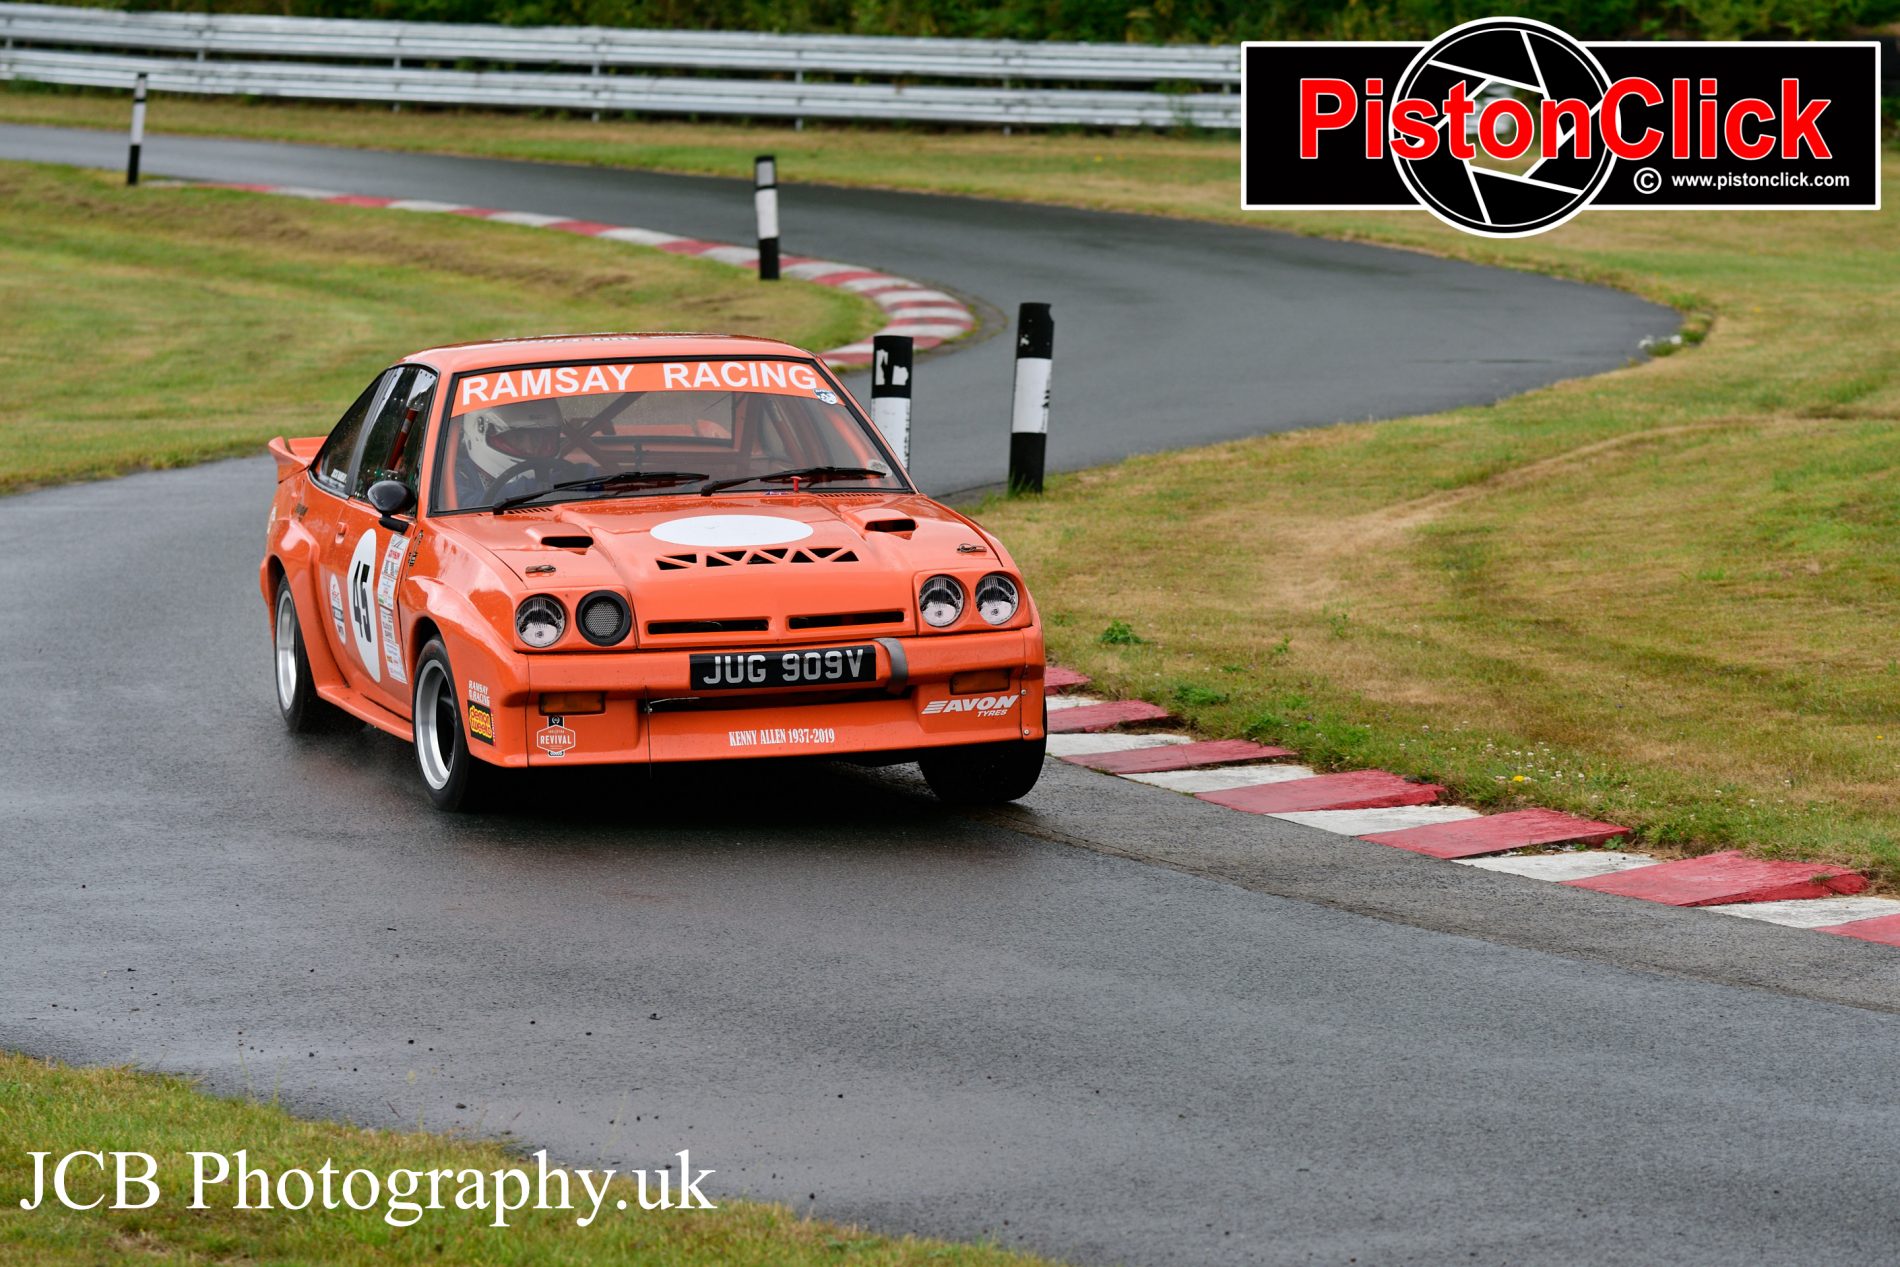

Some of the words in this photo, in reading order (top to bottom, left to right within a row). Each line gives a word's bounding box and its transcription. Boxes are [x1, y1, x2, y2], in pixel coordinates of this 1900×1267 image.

[462, 364, 634, 406] RAMSAY
[664, 360, 818, 390] RACING
[353, 560, 372, 644] 45
[703, 653, 767, 685] JUG
[781, 648, 864, 682] 909V
[942, 694, 1019, 713] AVON
[977, 709, 1008, 718] TYRES
[540, 735, 572, 745] REVIVAL
[728, 730, 758, 747] KENNY
[760, 729, 787, 745] ALLEN
[788, 728, 835, 744] 1937-2019
